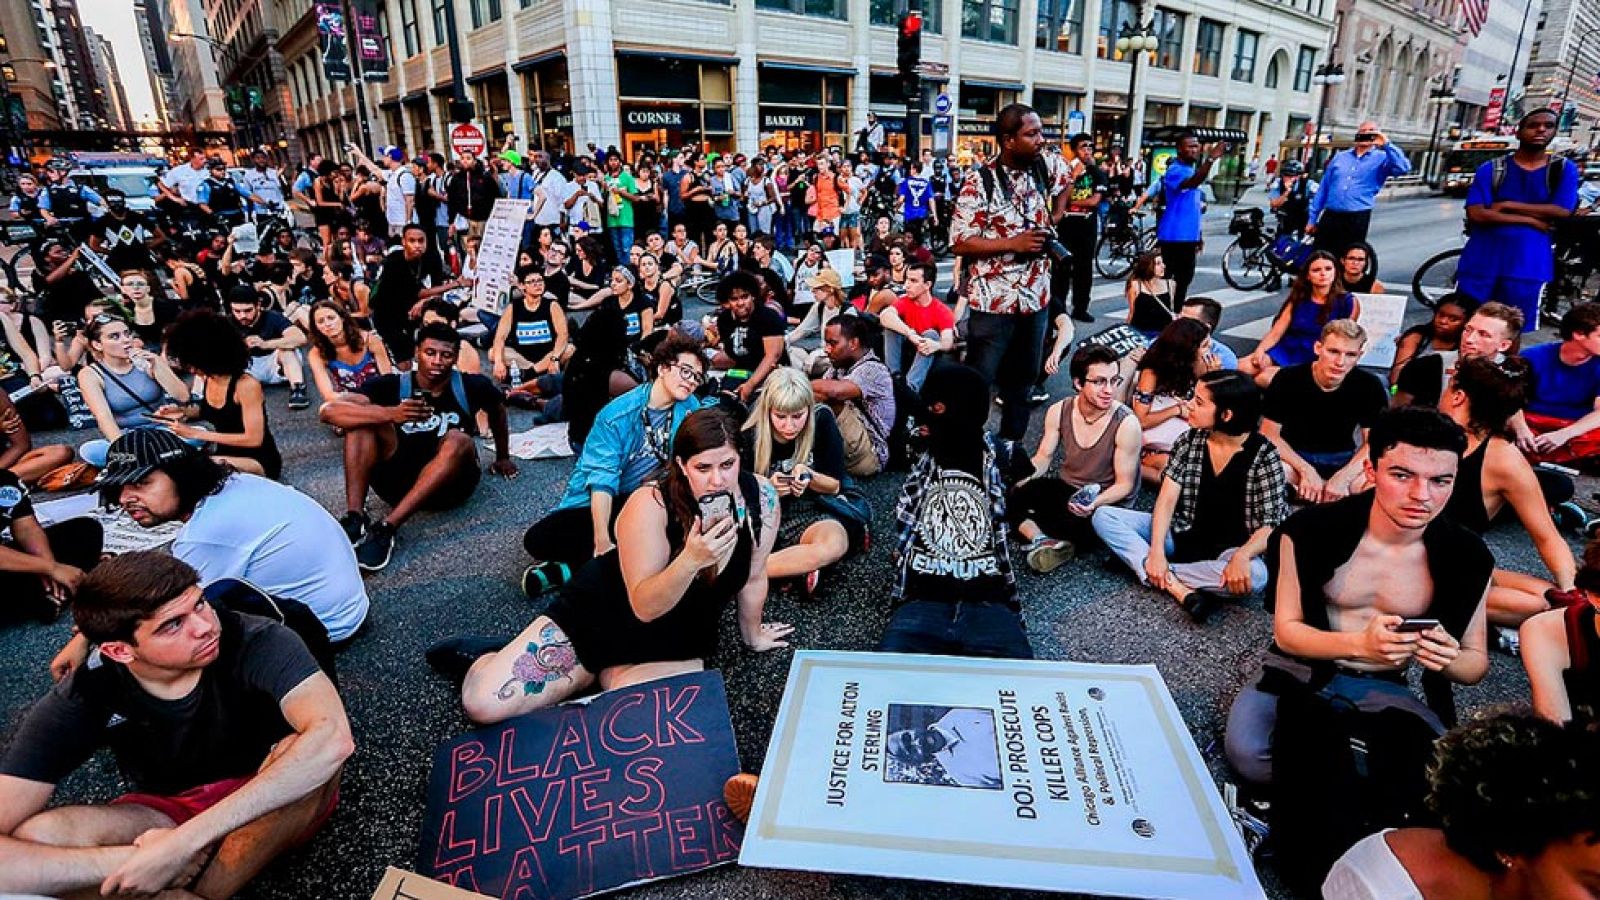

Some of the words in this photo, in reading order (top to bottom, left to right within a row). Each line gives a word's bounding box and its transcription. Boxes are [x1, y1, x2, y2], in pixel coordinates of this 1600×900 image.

[627, 111, 682, 125] CORNER
[765, 115, 806, 127] BAKERY
[840, 681, 860, 719] ALTON
[836, 721, 855, 747] FOR
[862, 709, 883, 772] STERLING
[999, 690, 1029, 773] PROSECUTE
[1032, 705, 1055, 742] COPS
[1061, 714, 1080, 746] Against
[449, 685, 705, 803] BLACK
[826, 749, 852, 807] JUSTICE
[1040, 747, 1070, 801] KILLER
[1071, 747, 1089, 784] Alliance
[1089, 755, 1111, 794] Political
[434, 757, 667, 869] LIVES
[1012, 778, 1037, 820] DOJ:
[1082, 785, 1101, 825] Chicago
[1102, 797, 1115, 806] &
